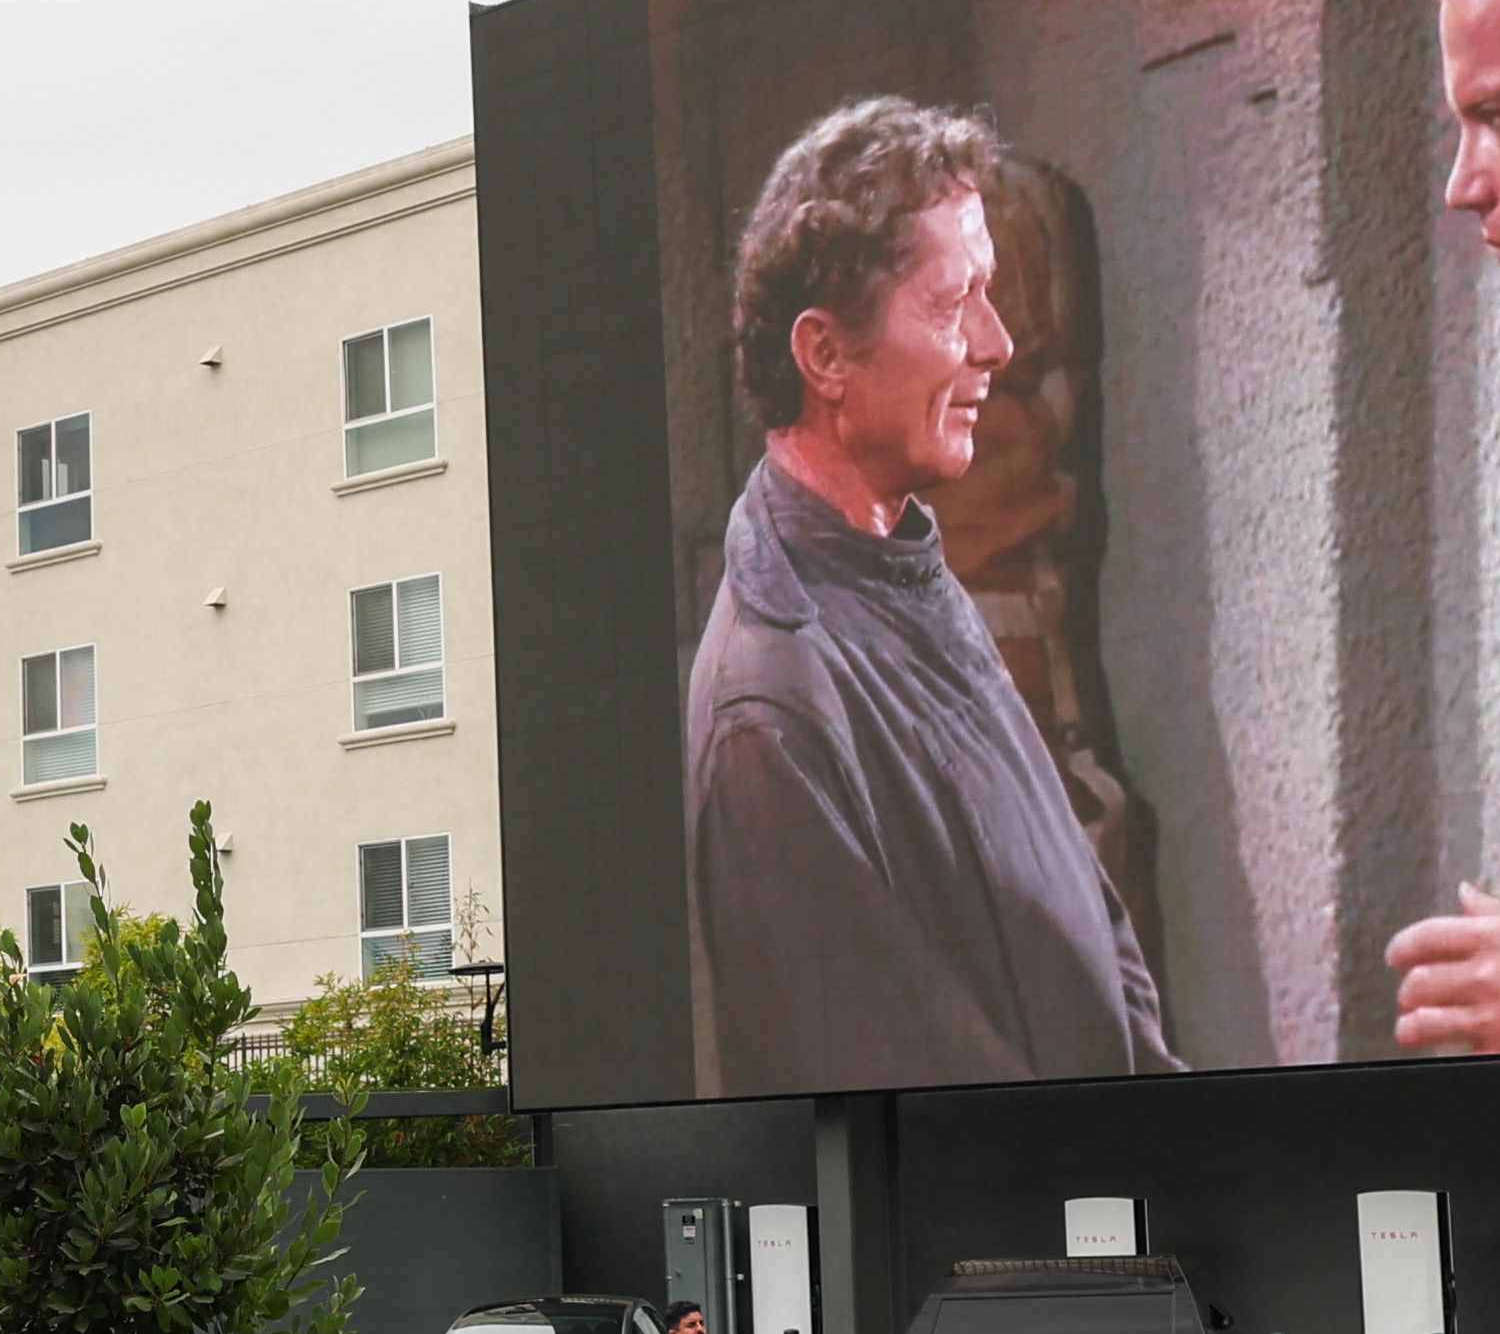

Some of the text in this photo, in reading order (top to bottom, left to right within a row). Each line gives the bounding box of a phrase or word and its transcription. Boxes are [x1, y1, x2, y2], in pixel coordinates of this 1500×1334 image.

[1075, 1235, 1118, 1244] TESLA
[1371, 1231, 1419, 1240] TESLA
[758, 1239, 792, 1247] TESLA
